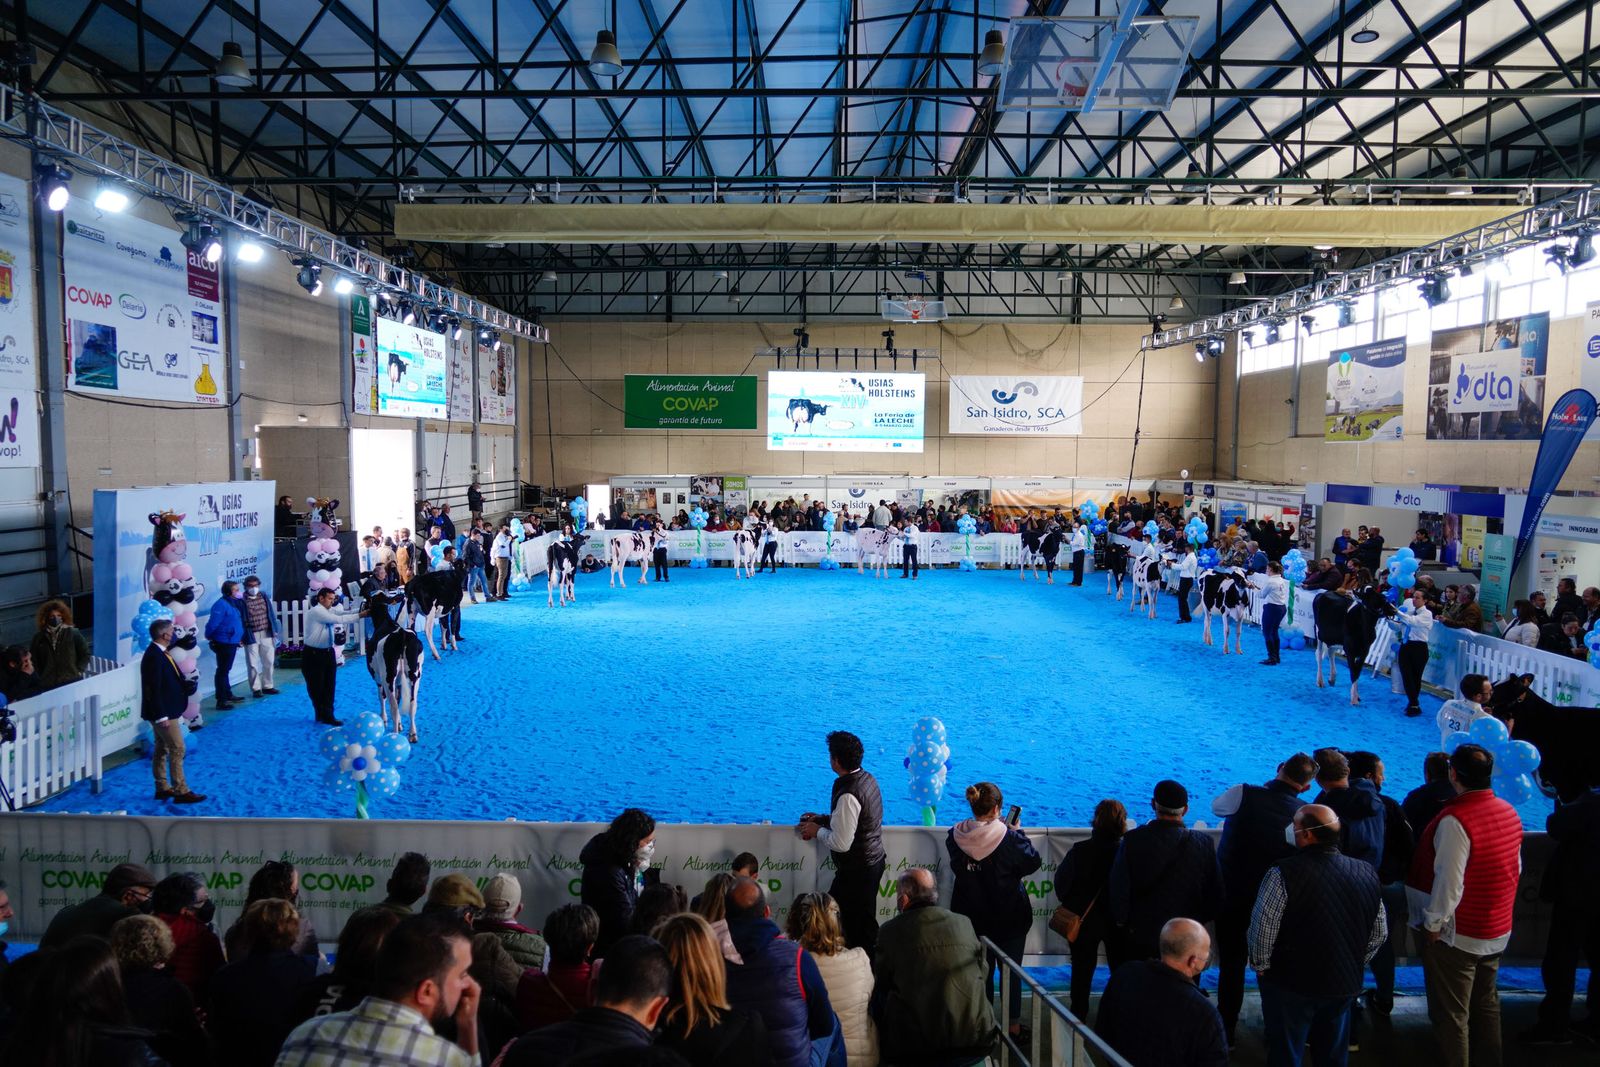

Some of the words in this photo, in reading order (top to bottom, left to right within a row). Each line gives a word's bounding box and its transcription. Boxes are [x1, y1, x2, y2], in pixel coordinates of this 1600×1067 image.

[68, 286, 112, 308] COVAP
[118, 350, 153, 372] GEA
[647, 380, 699, 391] Alimentación
[702, 380, 735, 391] Animal
[1474, 371, 1513, 401] dta
[868, 389, 915, 398] HOLSTEINS
[662, 397, 719, 411] COVAP
[966, 406, 988, 418] San
[993, 407, 1031, 420] Isidro,
[1037, 408, 1065, 418] SCA
[690, 416, 699, 424] de
[700, 417, 723, 425] futuro
[983, 425, 1014, 433] Ganaderos
[1015, 425, 1031, 433] desde
[1403, 494, 1421, 506] dta
[222, 511, 259, 531] HOLSTEINS
[1568, 525, 1598, 534] INNOFARM
[226, 560, 234, 568] La
[234, 556, 248, 566] Feria
[226, 569, 235, 579] LA
[236, 564, 257, 578] LECHE
[101, 707, 131, 727] COVAP
[1449, 719, 1461, 731] 23
[91, 848, 132, 865] Animal
[144, 849, 216, 865] Alimentación
[220, 850, 264, 865] Animal
[352, 851, 397, 868] Animal
[487, 853, 532, 870] Animal
[759, 856, 805, 872] Animal
[301, 873, 375, 893] COVAP
[339, 899, 351, 909] de
[879, 906, 890, 916] de
